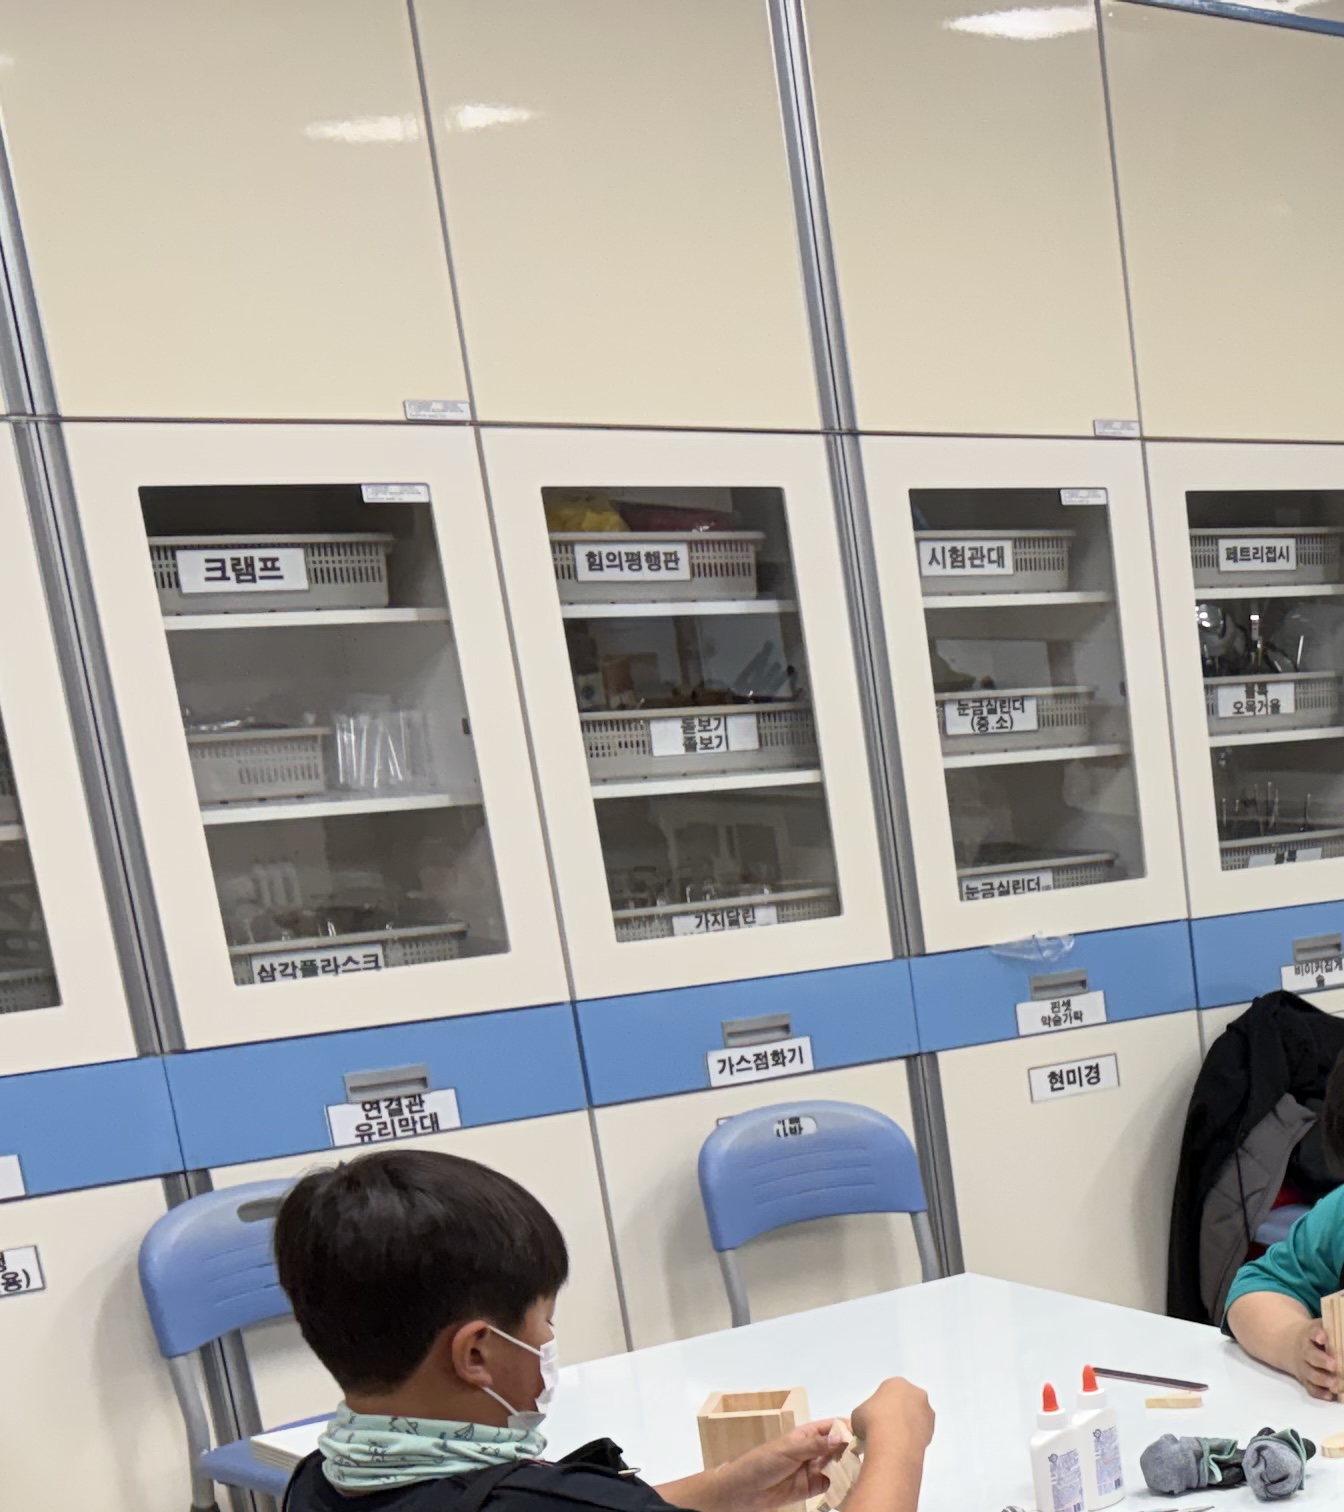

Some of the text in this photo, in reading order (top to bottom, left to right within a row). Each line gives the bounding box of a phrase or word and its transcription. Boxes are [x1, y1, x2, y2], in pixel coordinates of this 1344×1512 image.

[585, 550, 681, 572] 힘의평행판
[928, 545, 1005, 570] 시험관대
[1225, 545, 1290, 563] 페트리접시
[204, 555, 284, 584] 크램프
[257, 952, 382, 983] 삼각플라스크
[1050, 998, 1072, 1014] 핀셋
[716, 1045, 805, 1076] 가스점화기
[1047, 1062, 1101, 1093] 현미경
[361, 1093, 425, 1121] 연결관
[354, 1111, 440, 1143] 유리막대
